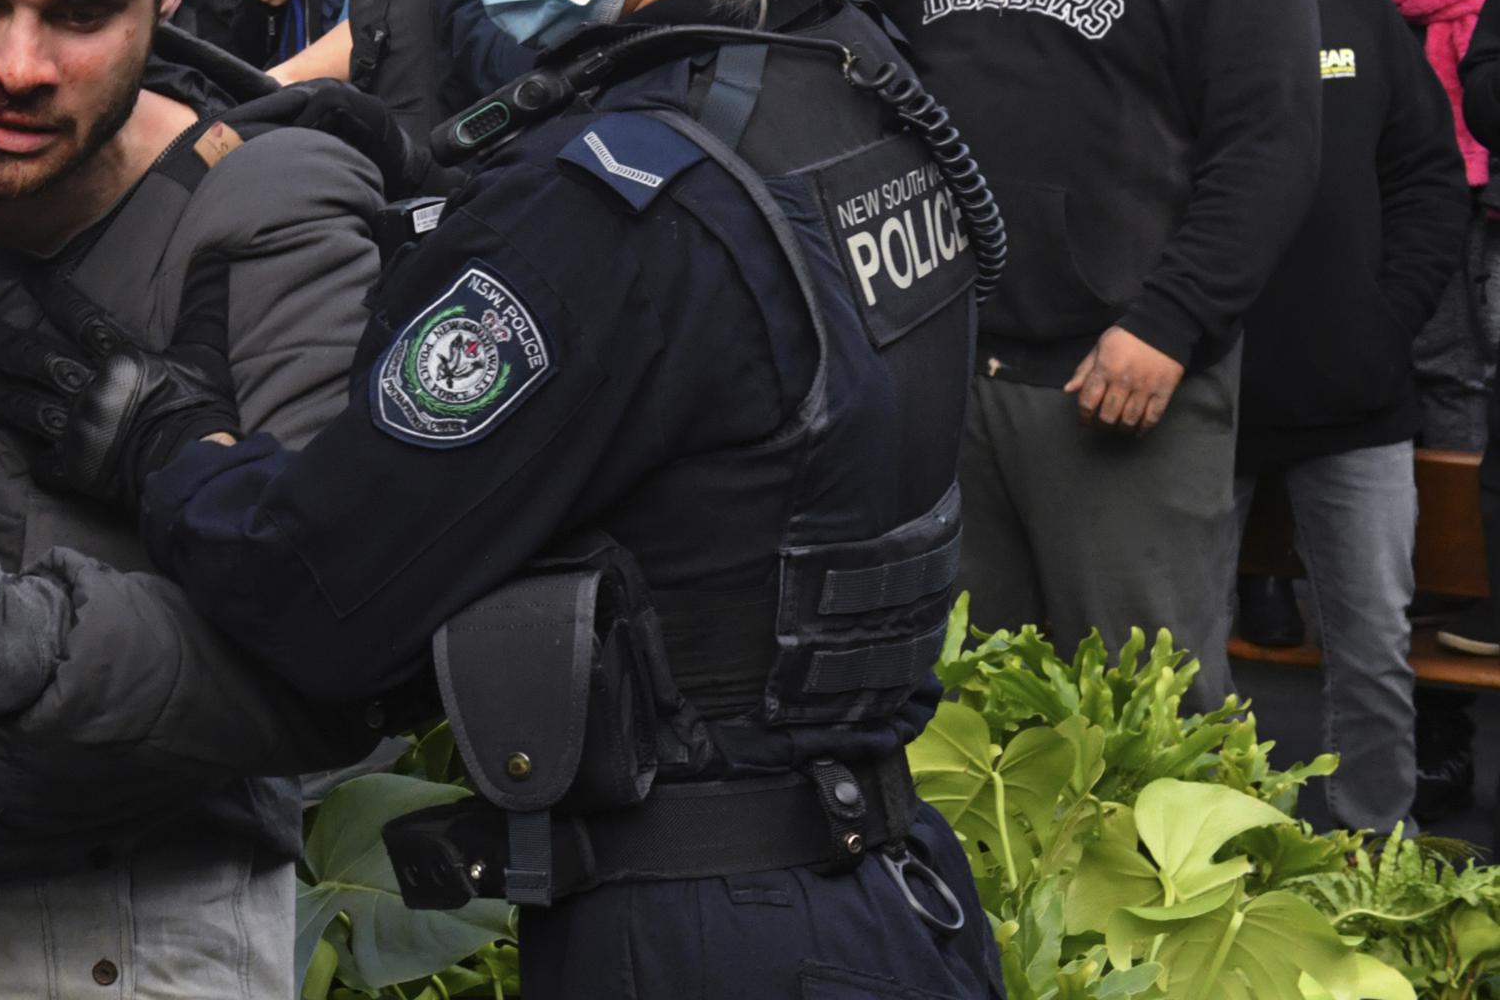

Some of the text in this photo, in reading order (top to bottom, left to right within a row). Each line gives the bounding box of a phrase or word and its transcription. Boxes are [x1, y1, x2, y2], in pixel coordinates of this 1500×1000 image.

[836, 188, 880, 230] NEW
[881, 165, 928, 211] SOUTH
[846, 186, 970, 307] POLICE
[433, 319, 461, 340] NEW
[501, 304, 544, 370] POLICE
[418, 343, 435, 389] POLICE
[430, 385, 470, 402] FORCE
